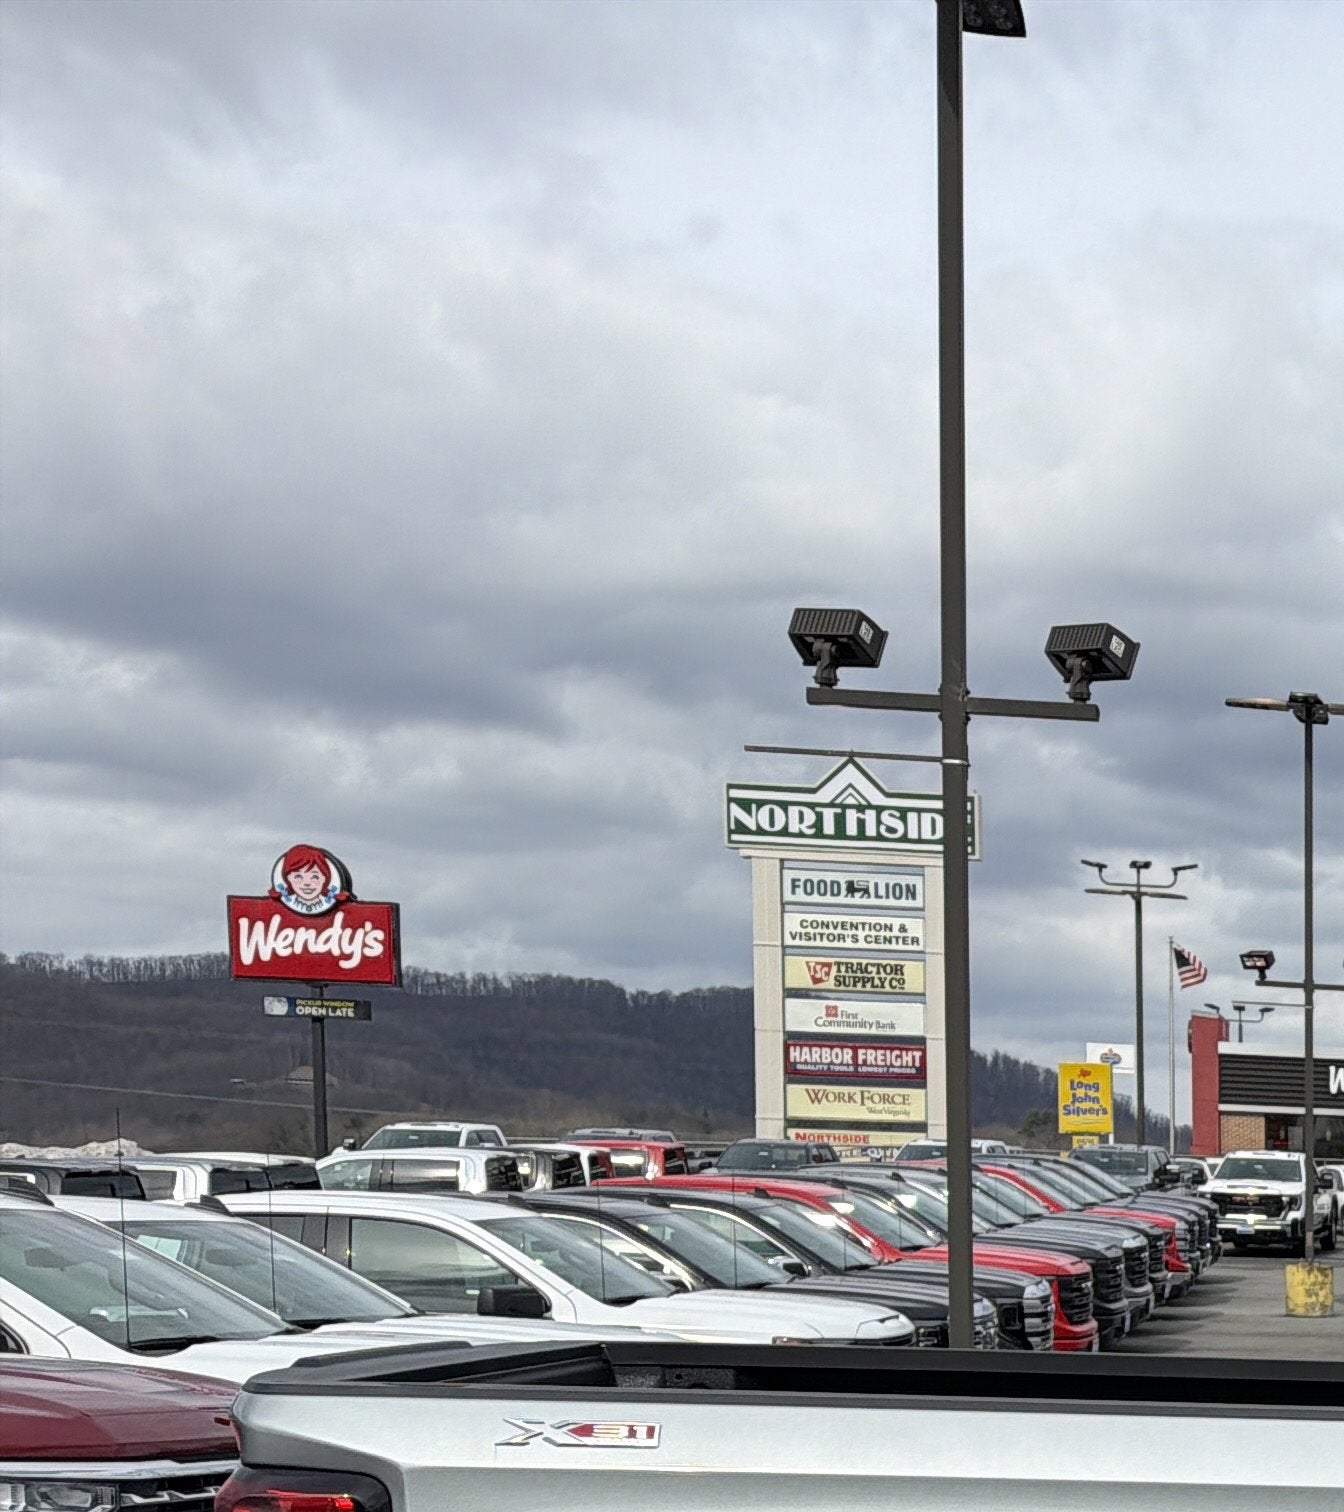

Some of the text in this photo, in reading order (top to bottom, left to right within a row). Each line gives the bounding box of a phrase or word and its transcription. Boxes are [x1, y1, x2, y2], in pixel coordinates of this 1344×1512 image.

[730, 802, 944, 840] NORTHSID
[790, 877, 917, 901] FOOD LION
[799, 919, 908, 933] CONVENTION &
[238, 911, 384, 969] Wendy's
[789, 931, 920, 946] VISITOR'S CENTER
[834, 961, 905, 976] TRACTOR
[834, 975, 886, 989] SUPPLY
[296, 1005, 355, 1017] OPEN LATE
[840, 1010, 859, 1020] First
[814, 1016, 896, 1031] Community Bank
[789, 1045, 922, 1068] HARBOR FREIGHT
[1069, 1079, 1100, 1093] Long
[805, 1087, 911, 1107] WORK FORCE
[1070, 1092, 1100, 1106] John
[1062, 1104, 1108, 1117] Silver's
[795, 1132, 870, 1145] NORTHSIDE
